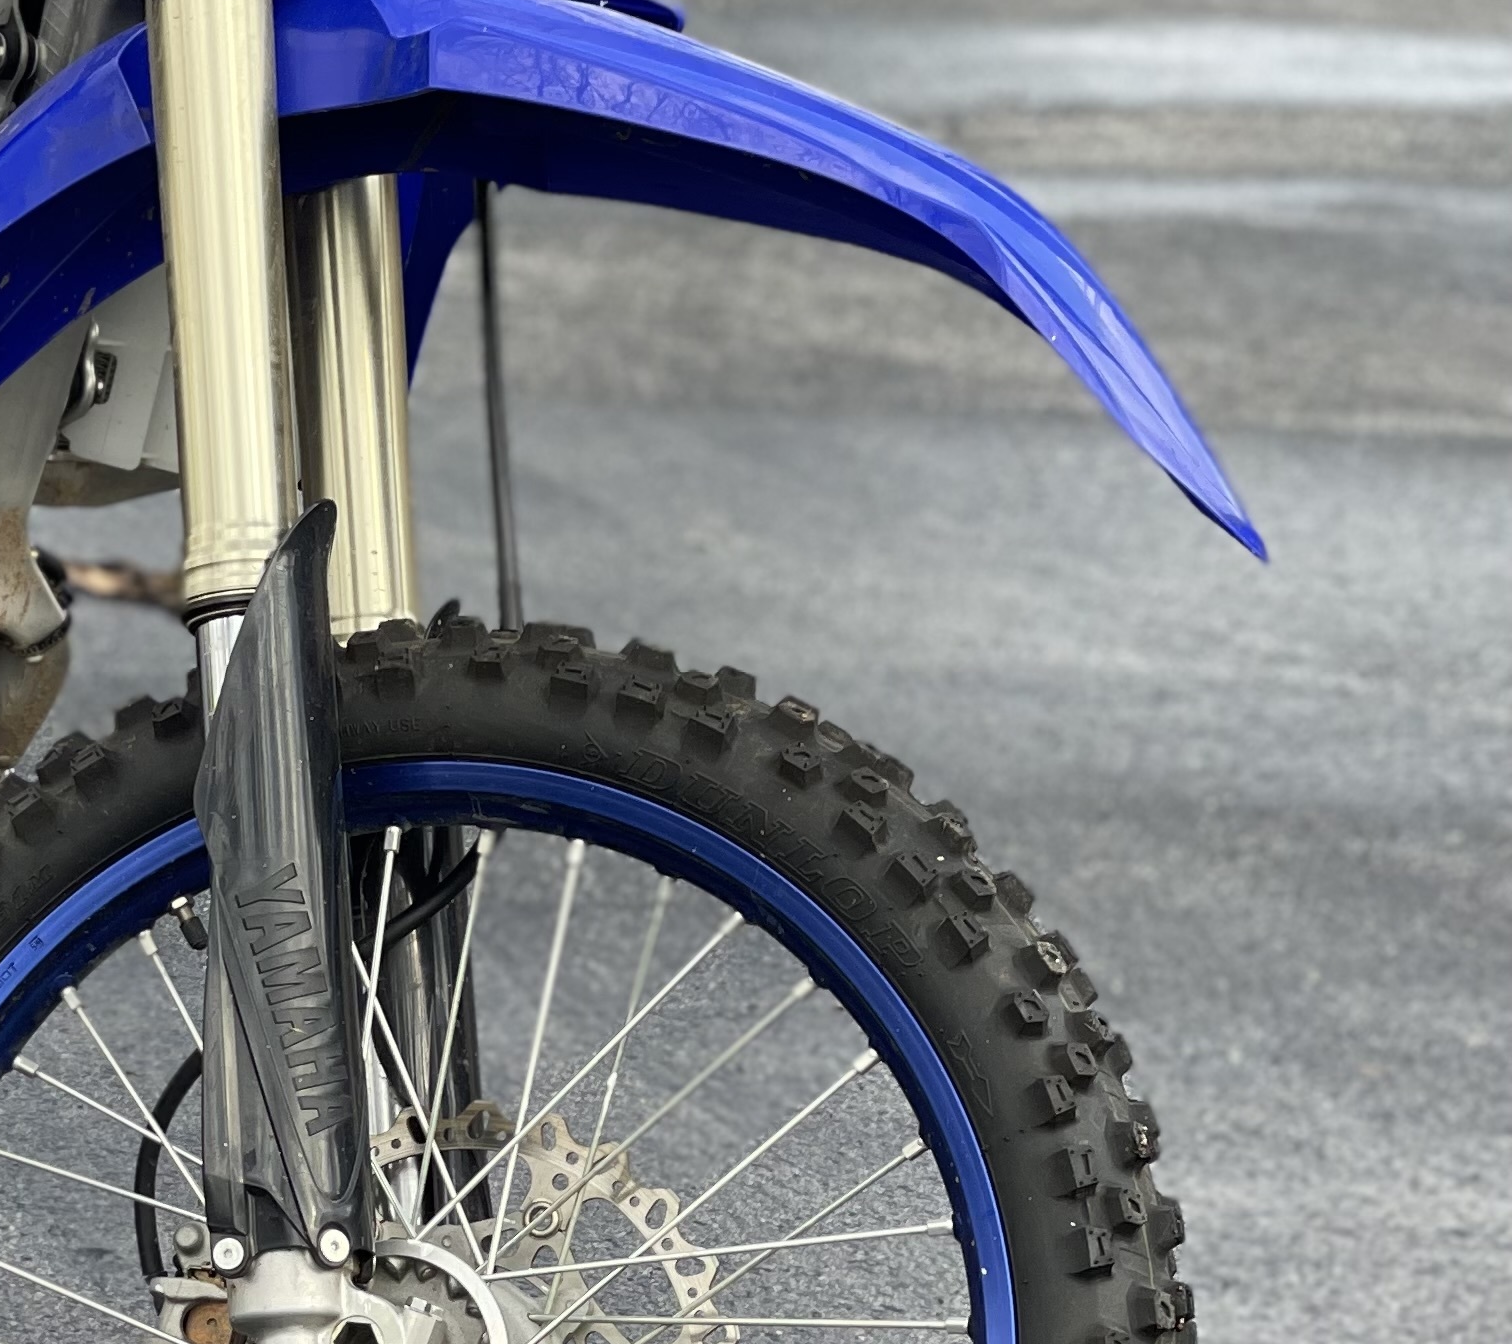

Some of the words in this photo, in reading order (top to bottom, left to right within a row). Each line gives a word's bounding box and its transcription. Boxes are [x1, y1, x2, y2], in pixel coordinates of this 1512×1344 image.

[388, 717, 421, 732] USE
[618, 747, 923, 969] DUNLOP
[234, 862, 349, 1137] YAMAHA
